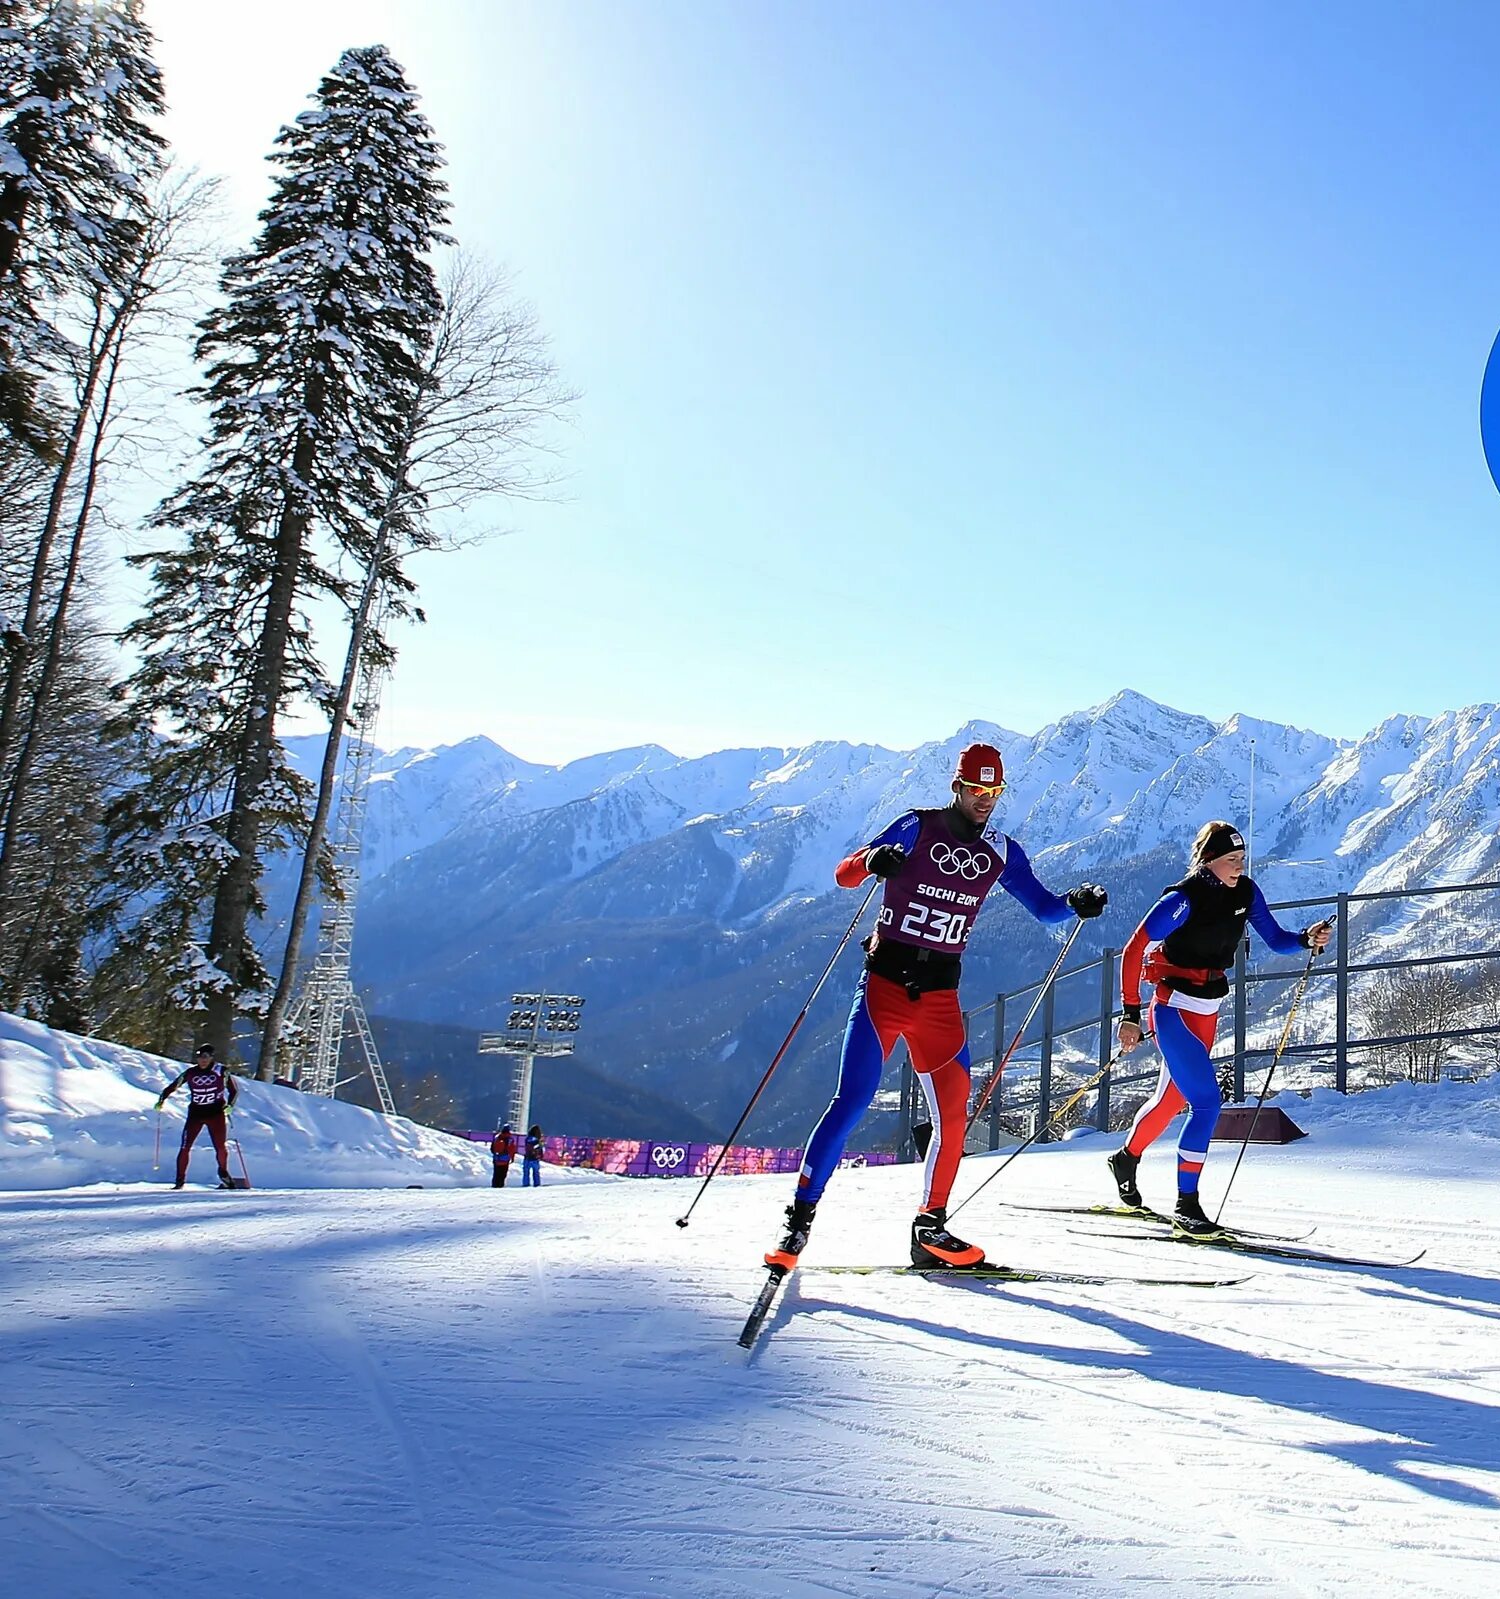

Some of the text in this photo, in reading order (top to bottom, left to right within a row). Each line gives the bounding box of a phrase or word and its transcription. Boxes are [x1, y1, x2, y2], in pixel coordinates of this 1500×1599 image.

[917, 884, 980, 907] SOCHI 2014
[900, 902, 967, 945] 230
[193, 1093, 215, 1103] 272
